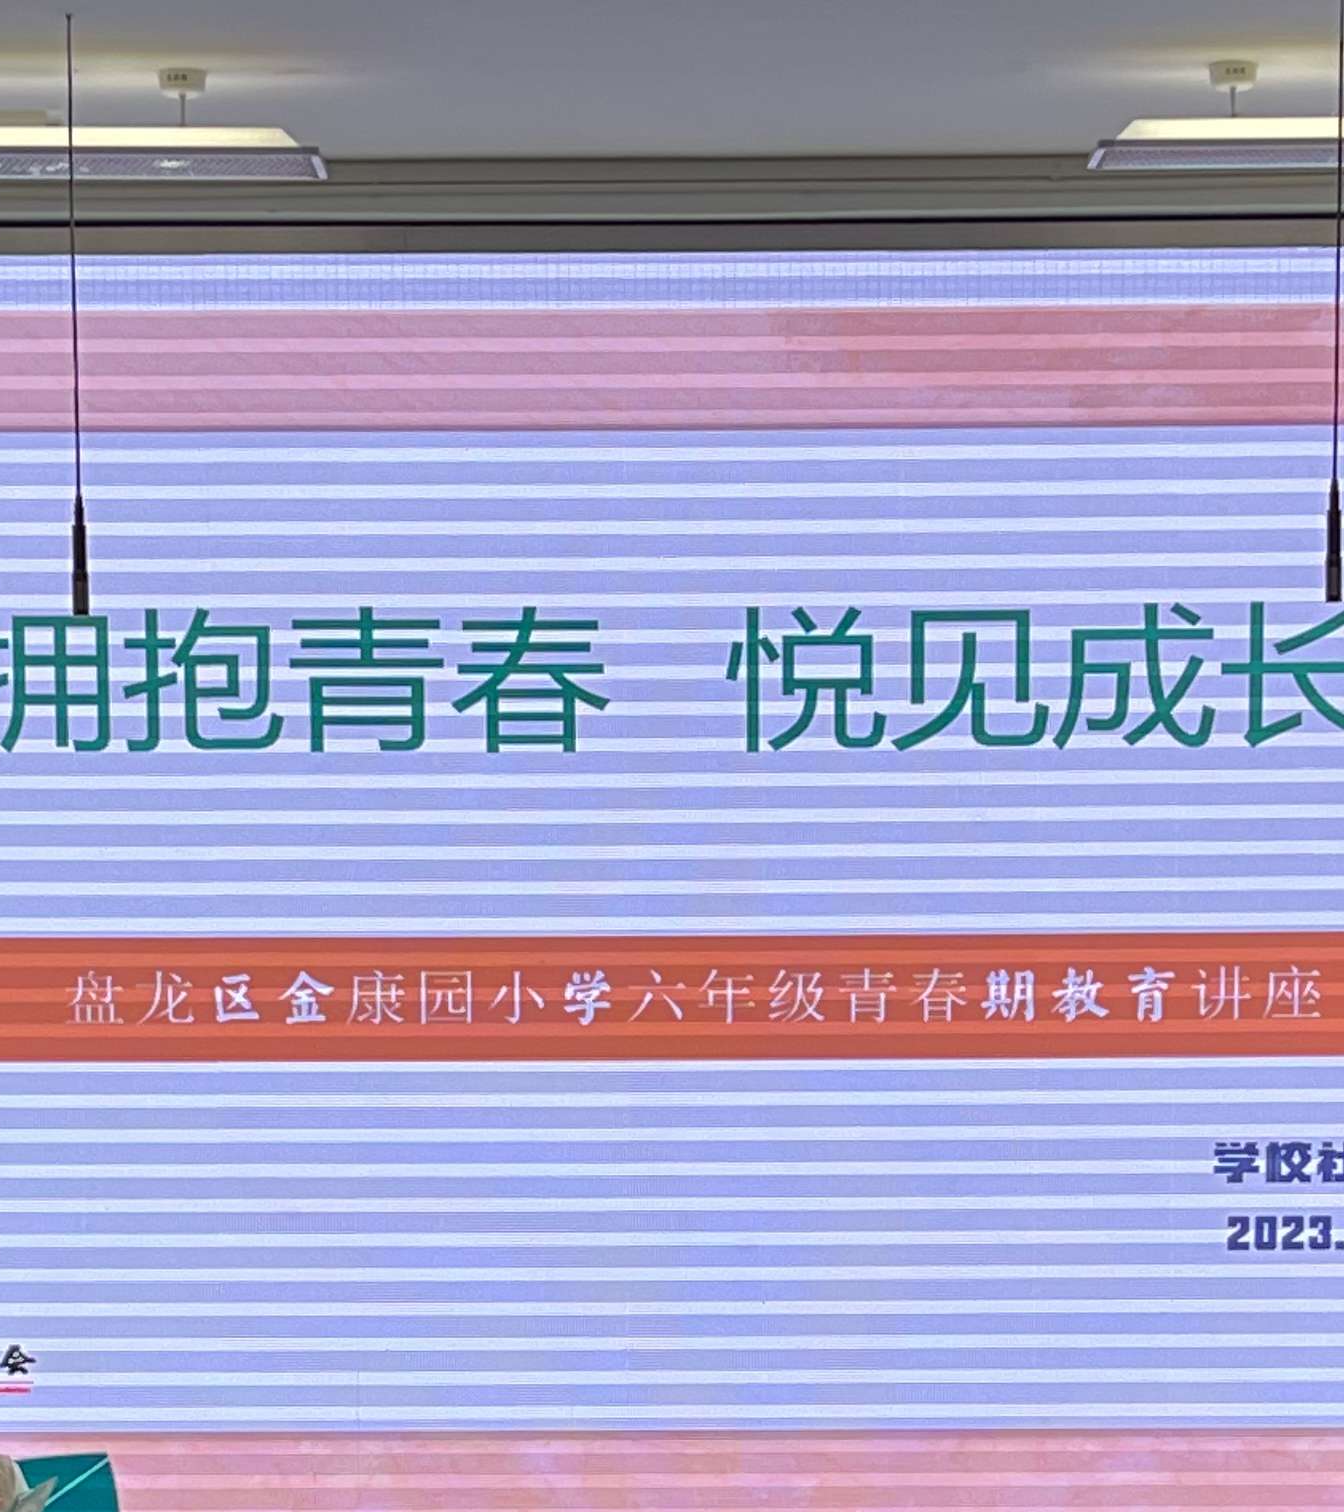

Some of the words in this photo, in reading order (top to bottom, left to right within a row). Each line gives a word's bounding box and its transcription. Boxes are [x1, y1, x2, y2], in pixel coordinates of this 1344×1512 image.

[64, 965, 1324, 1028] 盘龙区金康园小学六年级青春期教育讲座
